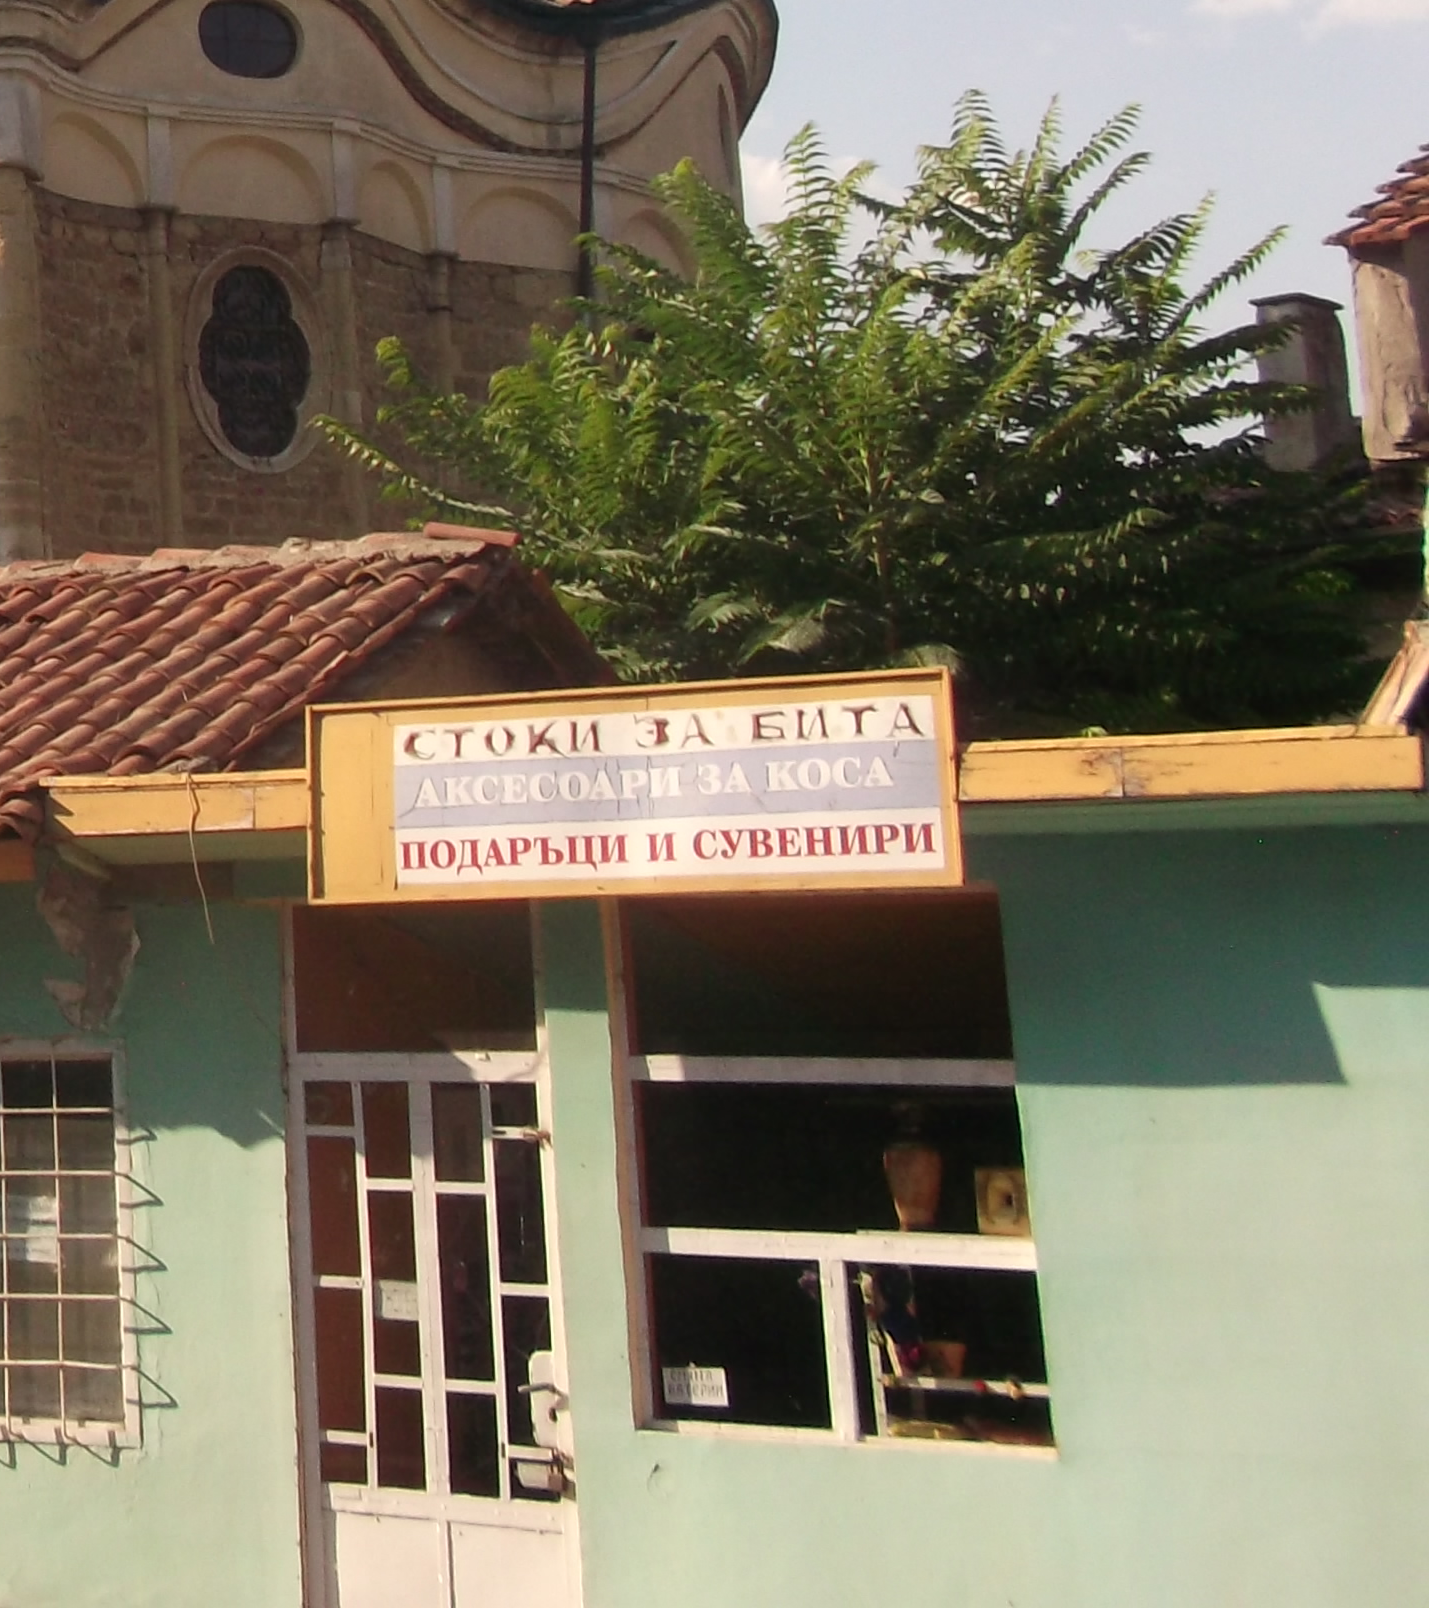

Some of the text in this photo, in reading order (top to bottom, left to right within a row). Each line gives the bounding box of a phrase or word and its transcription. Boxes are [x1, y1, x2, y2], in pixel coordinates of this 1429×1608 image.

[403, 702, 924, 760] СТОКИ ЗА БИТА
[415, 756, 894, 808] АКСЕСОАРИ ЗА КОСА
[401, 822, 937, 876] ПОДАРЪЦИ И СУВЕНИРИ
